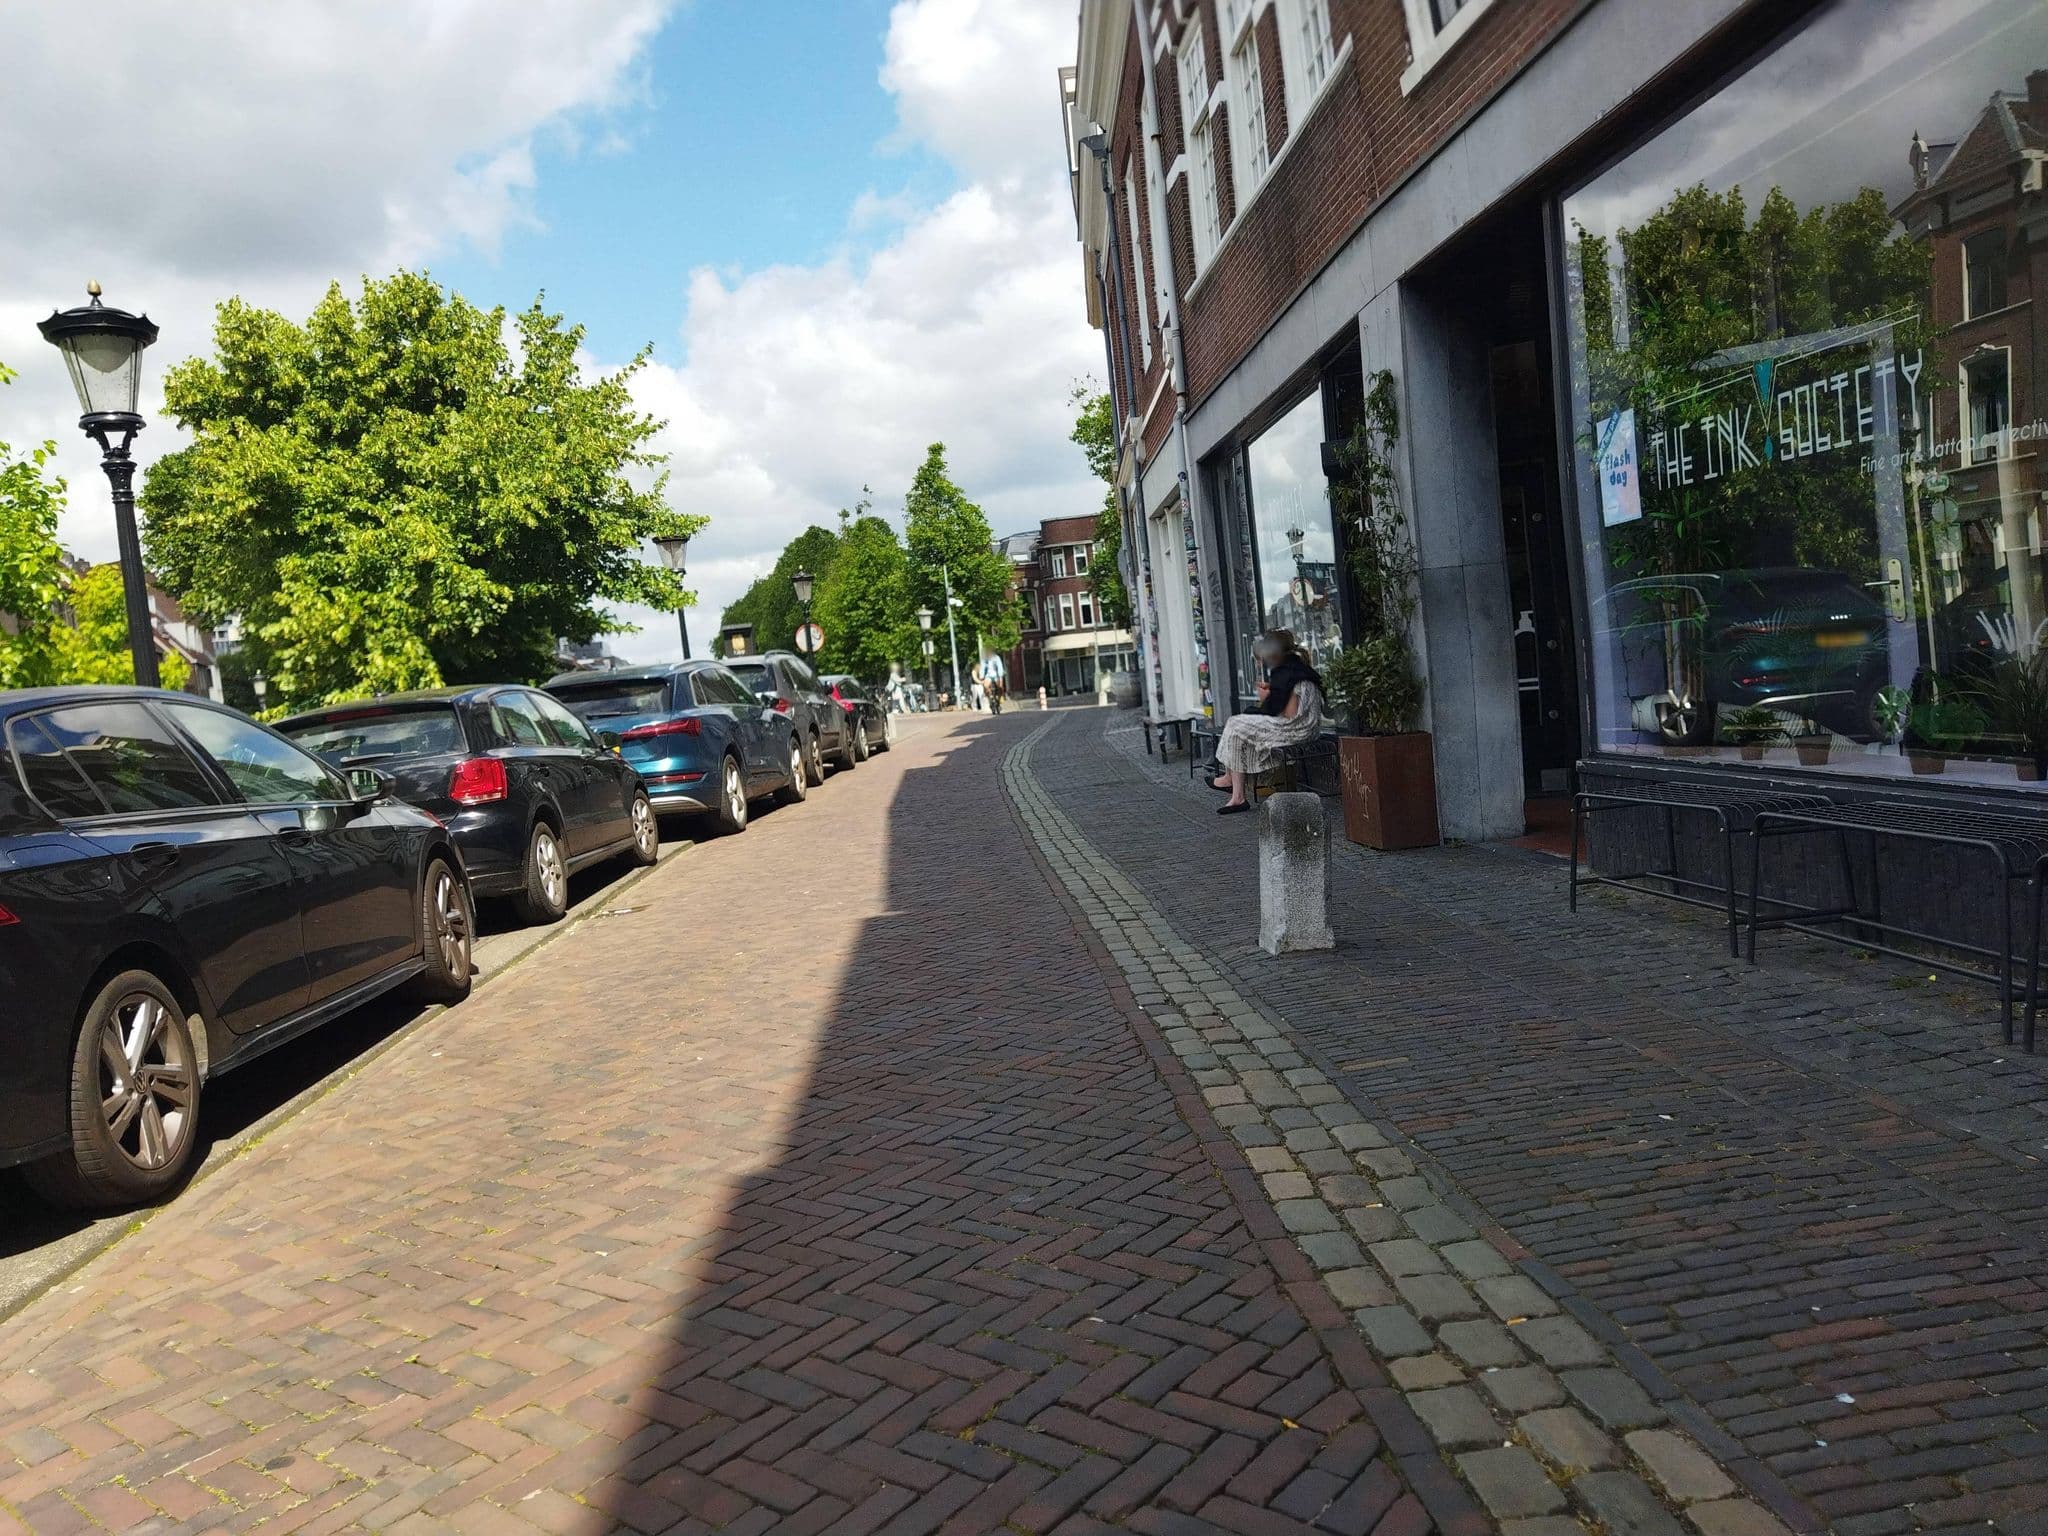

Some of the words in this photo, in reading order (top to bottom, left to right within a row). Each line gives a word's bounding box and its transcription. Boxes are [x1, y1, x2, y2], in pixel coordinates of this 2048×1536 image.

[1652, 422, 1694, 490] THE
[1701, 404, 1761, 480] INK
[1778, 349, 1923, 461] SOCIETY
[1860, 455, 1885, 474] Fine
